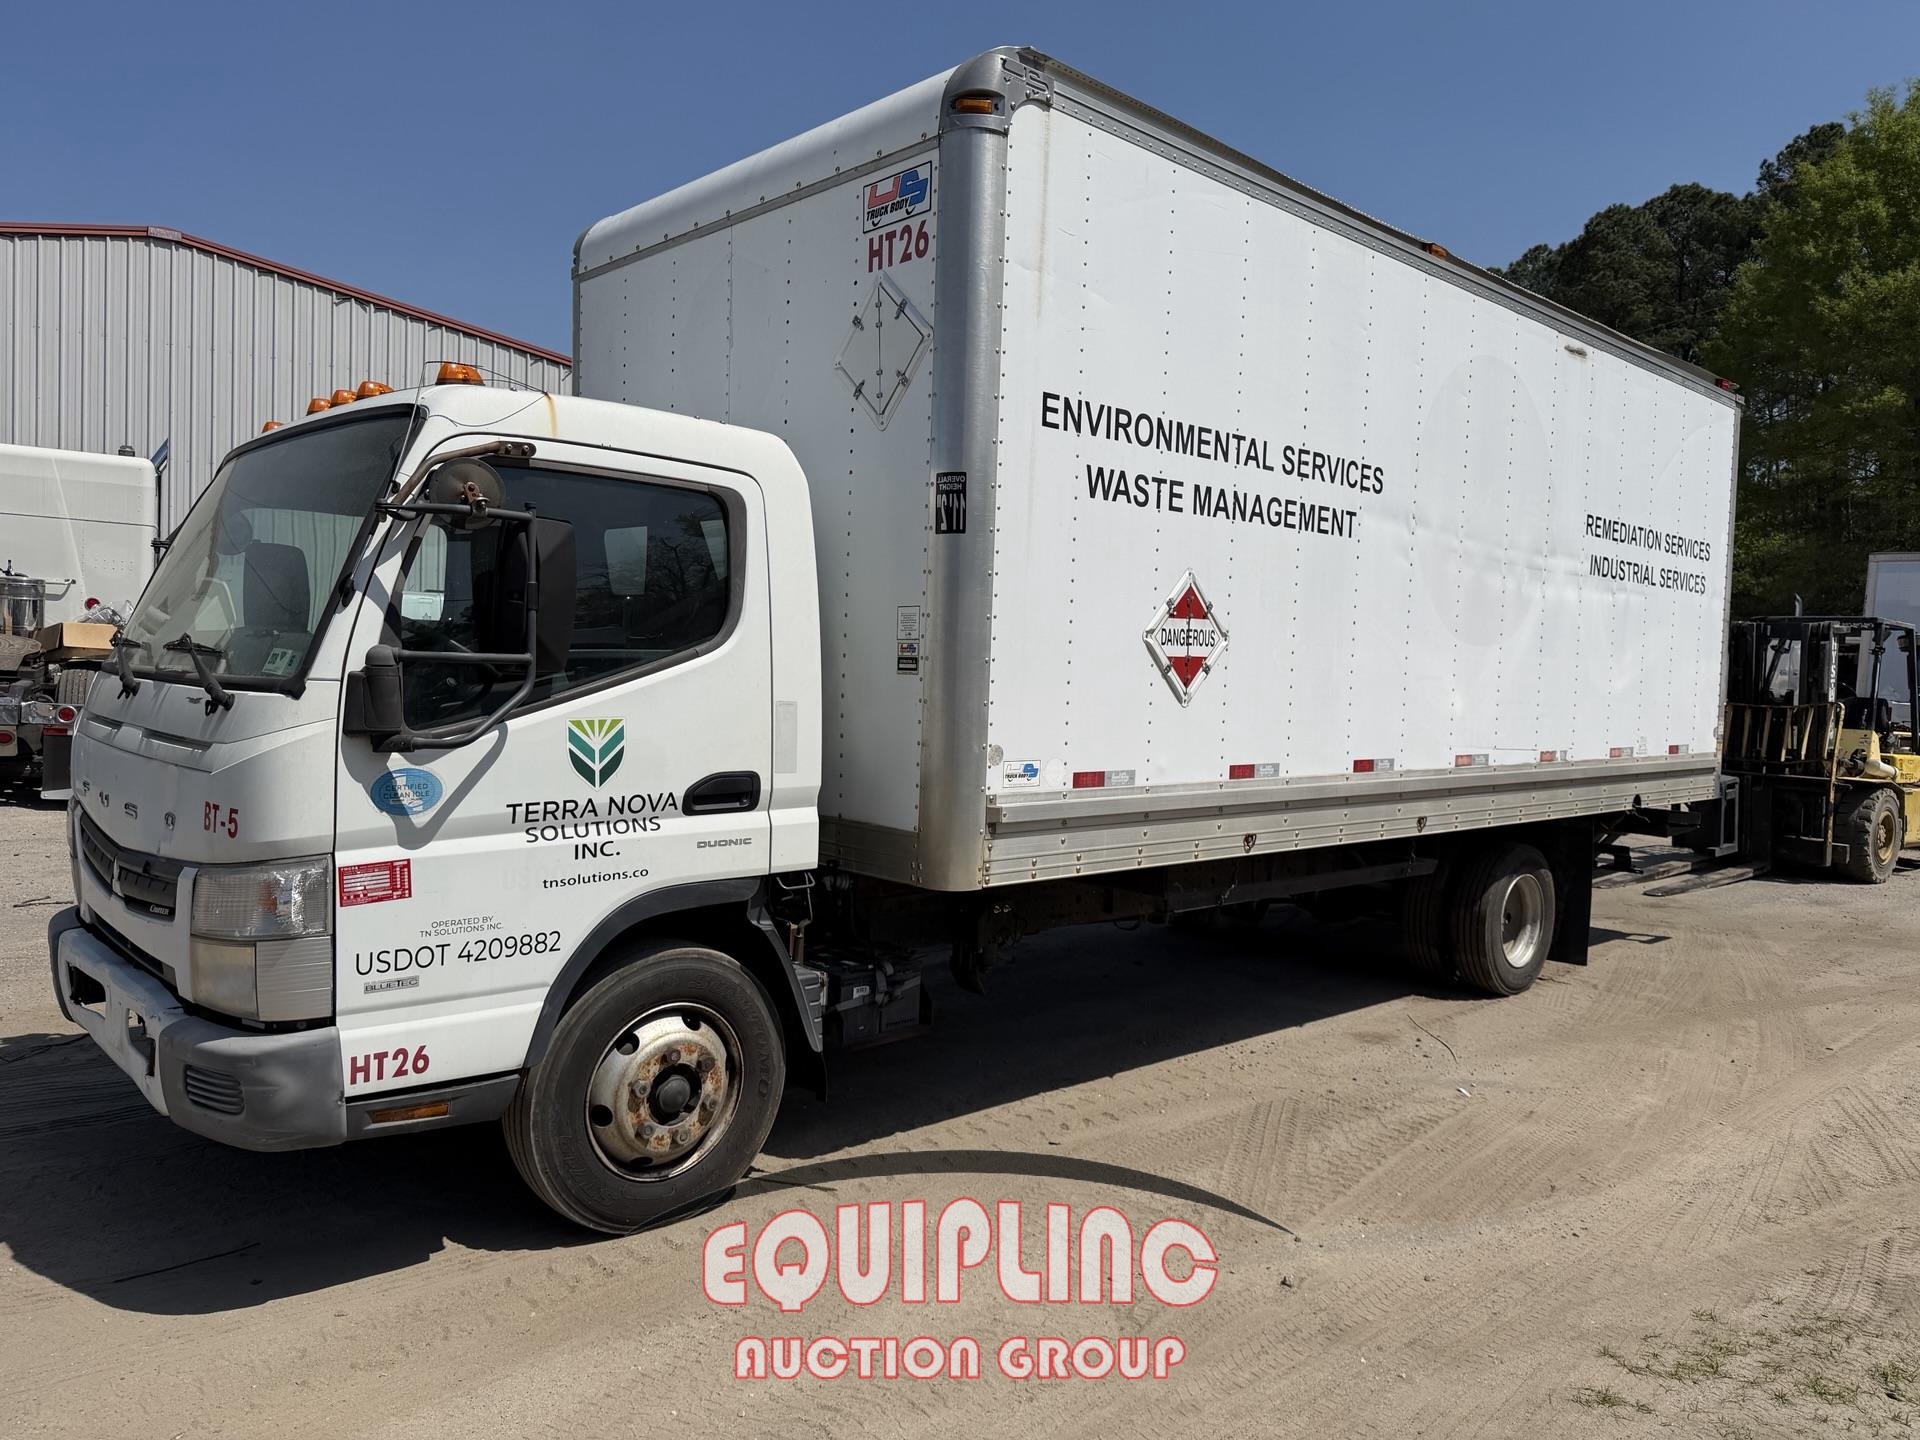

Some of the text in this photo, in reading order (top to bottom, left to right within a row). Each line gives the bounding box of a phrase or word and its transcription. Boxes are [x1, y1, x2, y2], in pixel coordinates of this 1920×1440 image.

[868, 170, 928, 209] US
[867, 197, 909, 221] TRUCK BODY
[868, 219, 929, 273] HT26
[1041, 391, 1384, 494] ENVIRONMENTAL SERVICES
[1086, 464, 1357, 538] WASTE MANAGEMENT
[1586, 514, 1711, 561] REMEDIATION SERVICES
[1590, 554, 1706, 594] INDUSTRIAL SERVICES
[1160, 628, 1215, 648] DANGEROUS
[203, 801, 239, 839] BT-5
[506, 792, 678, 824] TERRA NOVA
[525, 816, 661, 843] SOLUTIONS
[696, 838, 752, 848] DUONIC
[574, 841, 620, 860] INC.
[543, 868, 649, 888] tnsolutions.co
[420, 922, 503, 938] TN SOLUTIONS INC.
[431, 916, 494, 929] OPERATED BY
[355, 931, 561, 976] USDOT 4209882
[364, 979, 418, 992] BLUETEC
[350, 1045, 430, 1085] HT26
